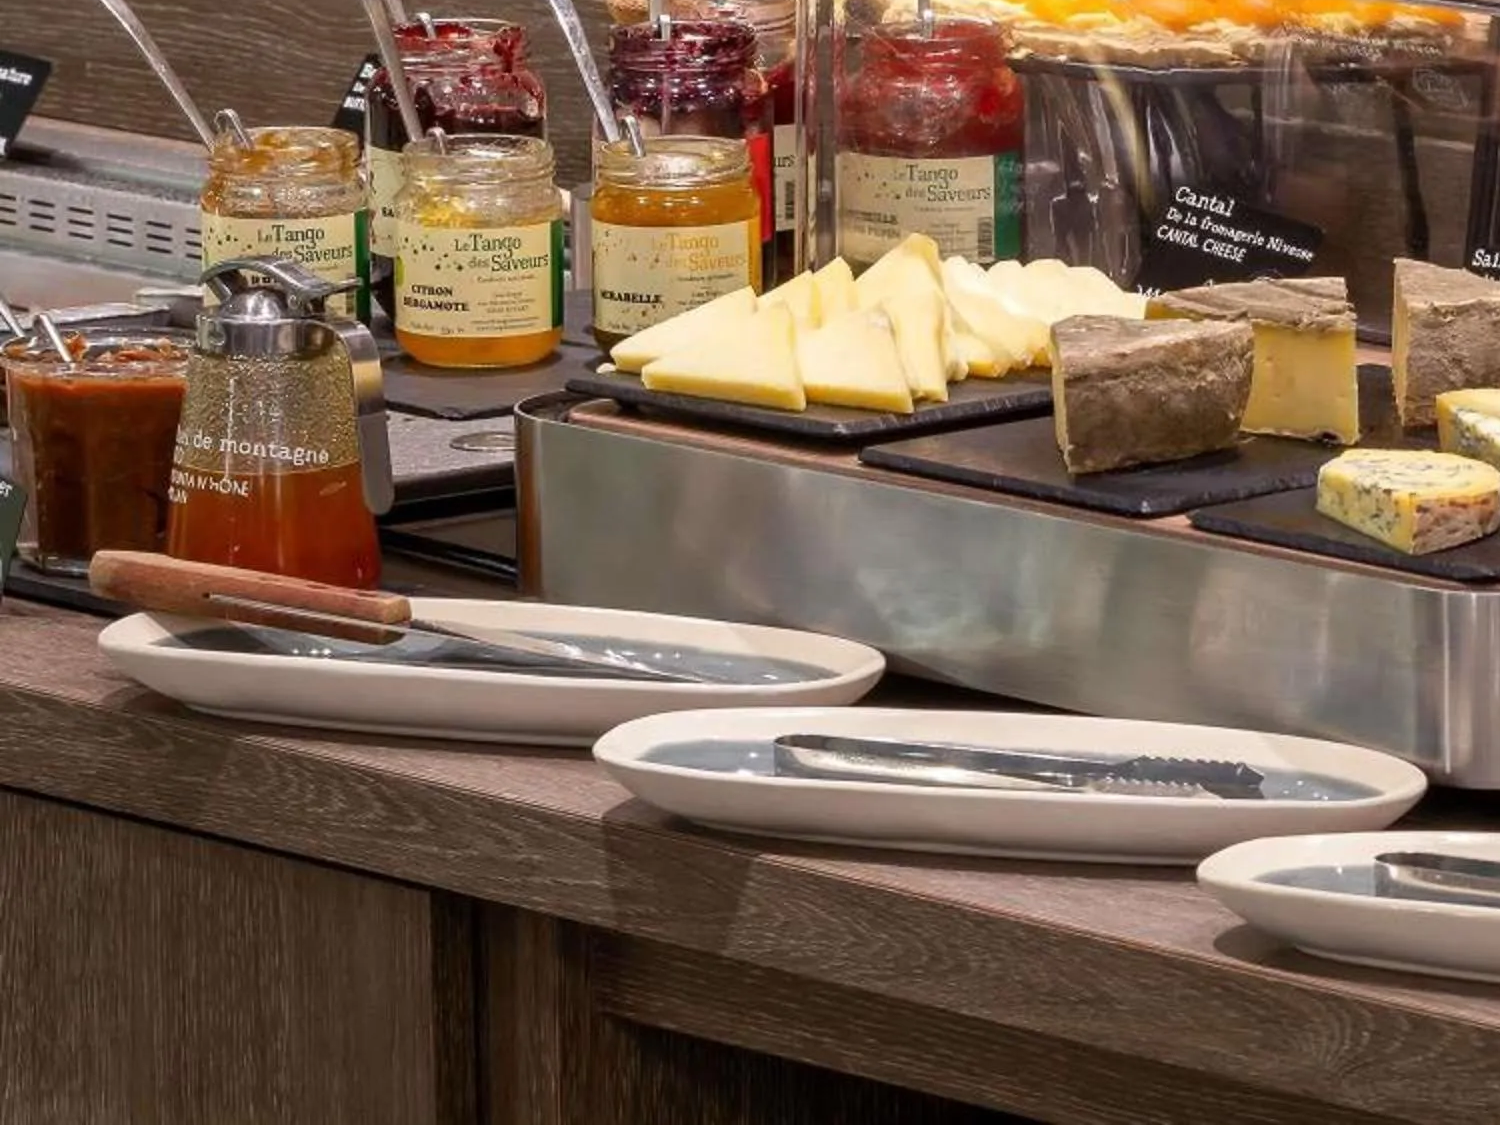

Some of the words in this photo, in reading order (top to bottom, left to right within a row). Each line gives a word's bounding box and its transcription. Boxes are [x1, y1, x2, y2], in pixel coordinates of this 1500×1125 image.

[906, 164, 959, 189] Tango
[1175, 185, 1236, 218] Cantal
[272, 224, 325, 250] Tango
[1184, 213, 1197, 226] la
[1201, 216, 1265, 246] fromagerie
[294, 244, 353, 264] Saveurs
[454, 237, 469, 252] Le
[469, 233, 522, 259] Tango
[1157, 224, 1200, 249] CANTAL
[1203, 237, 1248, 263] CHEESE
[468, 255, 490, 269] des
[491, 253, 550, 272] Saveurs
[411, 284, 453, 296] CITRON
[403, 296, 470, 312] BERGAMOTE
[218, 437, 330, 466] montagne
